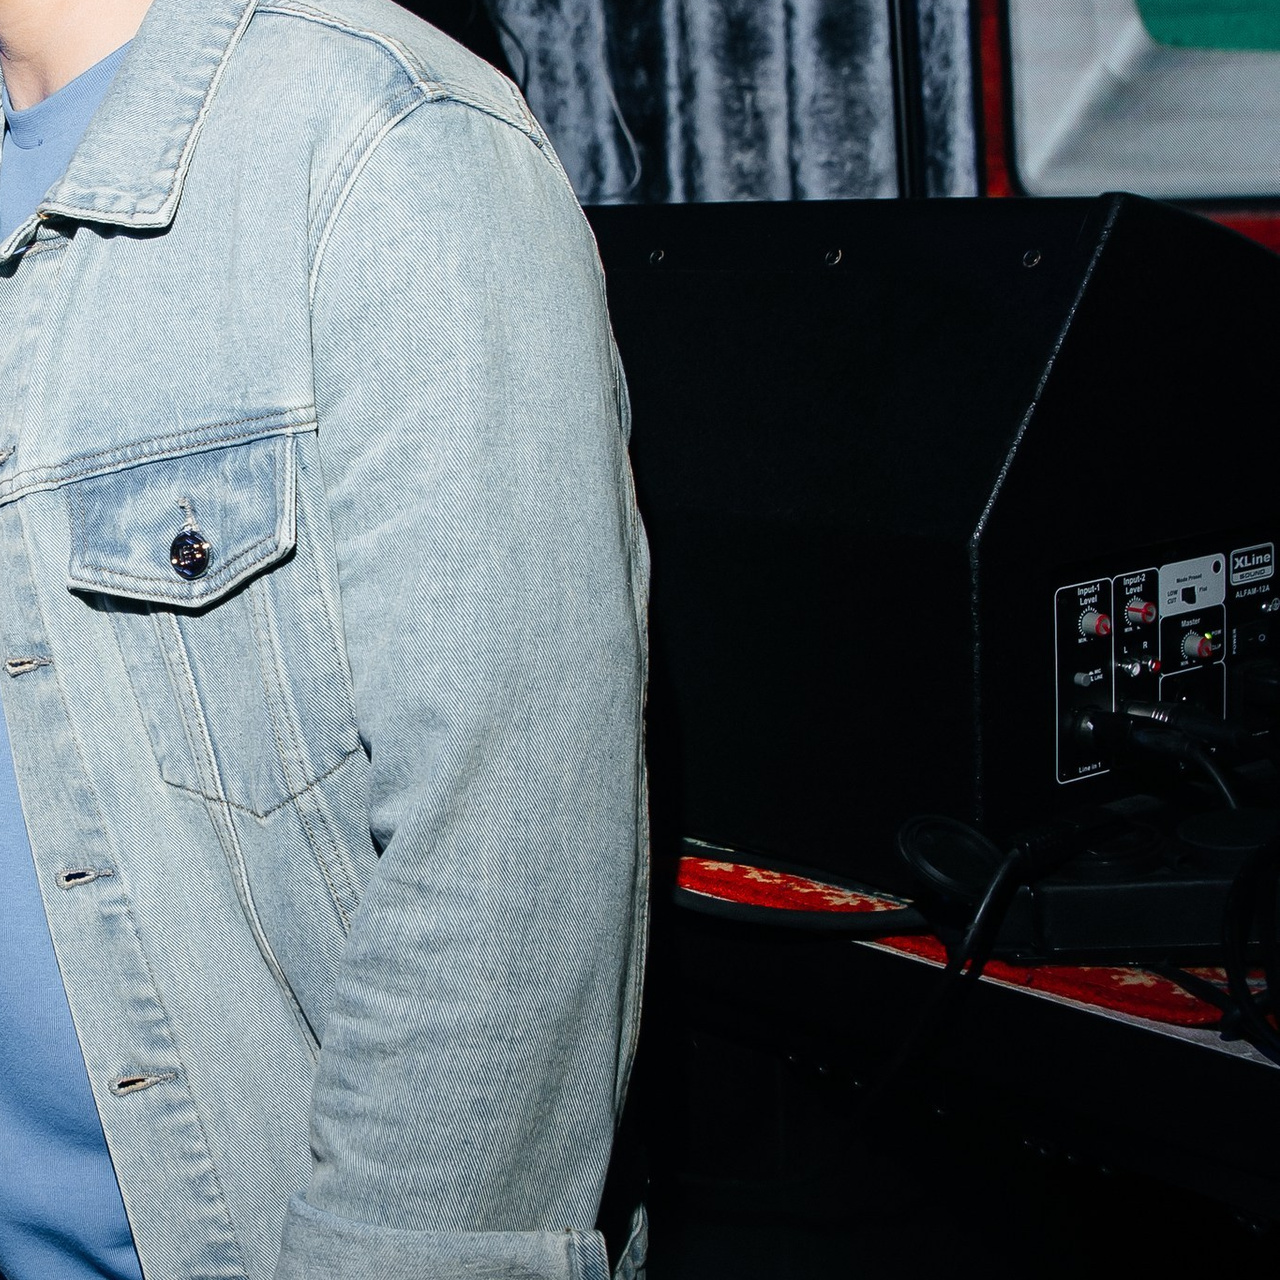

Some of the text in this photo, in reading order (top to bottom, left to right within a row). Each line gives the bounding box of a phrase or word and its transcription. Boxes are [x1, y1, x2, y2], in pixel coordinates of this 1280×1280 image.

[1234, 553, 1271, 570] XLine
[1239, 568, 1265, 579] SOUND
[1123, 574, 1146, 587] Input-2
[1077, 583, 1100, 597] Input-1
[1125, 584, 1143, 595] Level
[1079, 595, 1098, 606] Level
[1142, 641, 1148, 649] R
